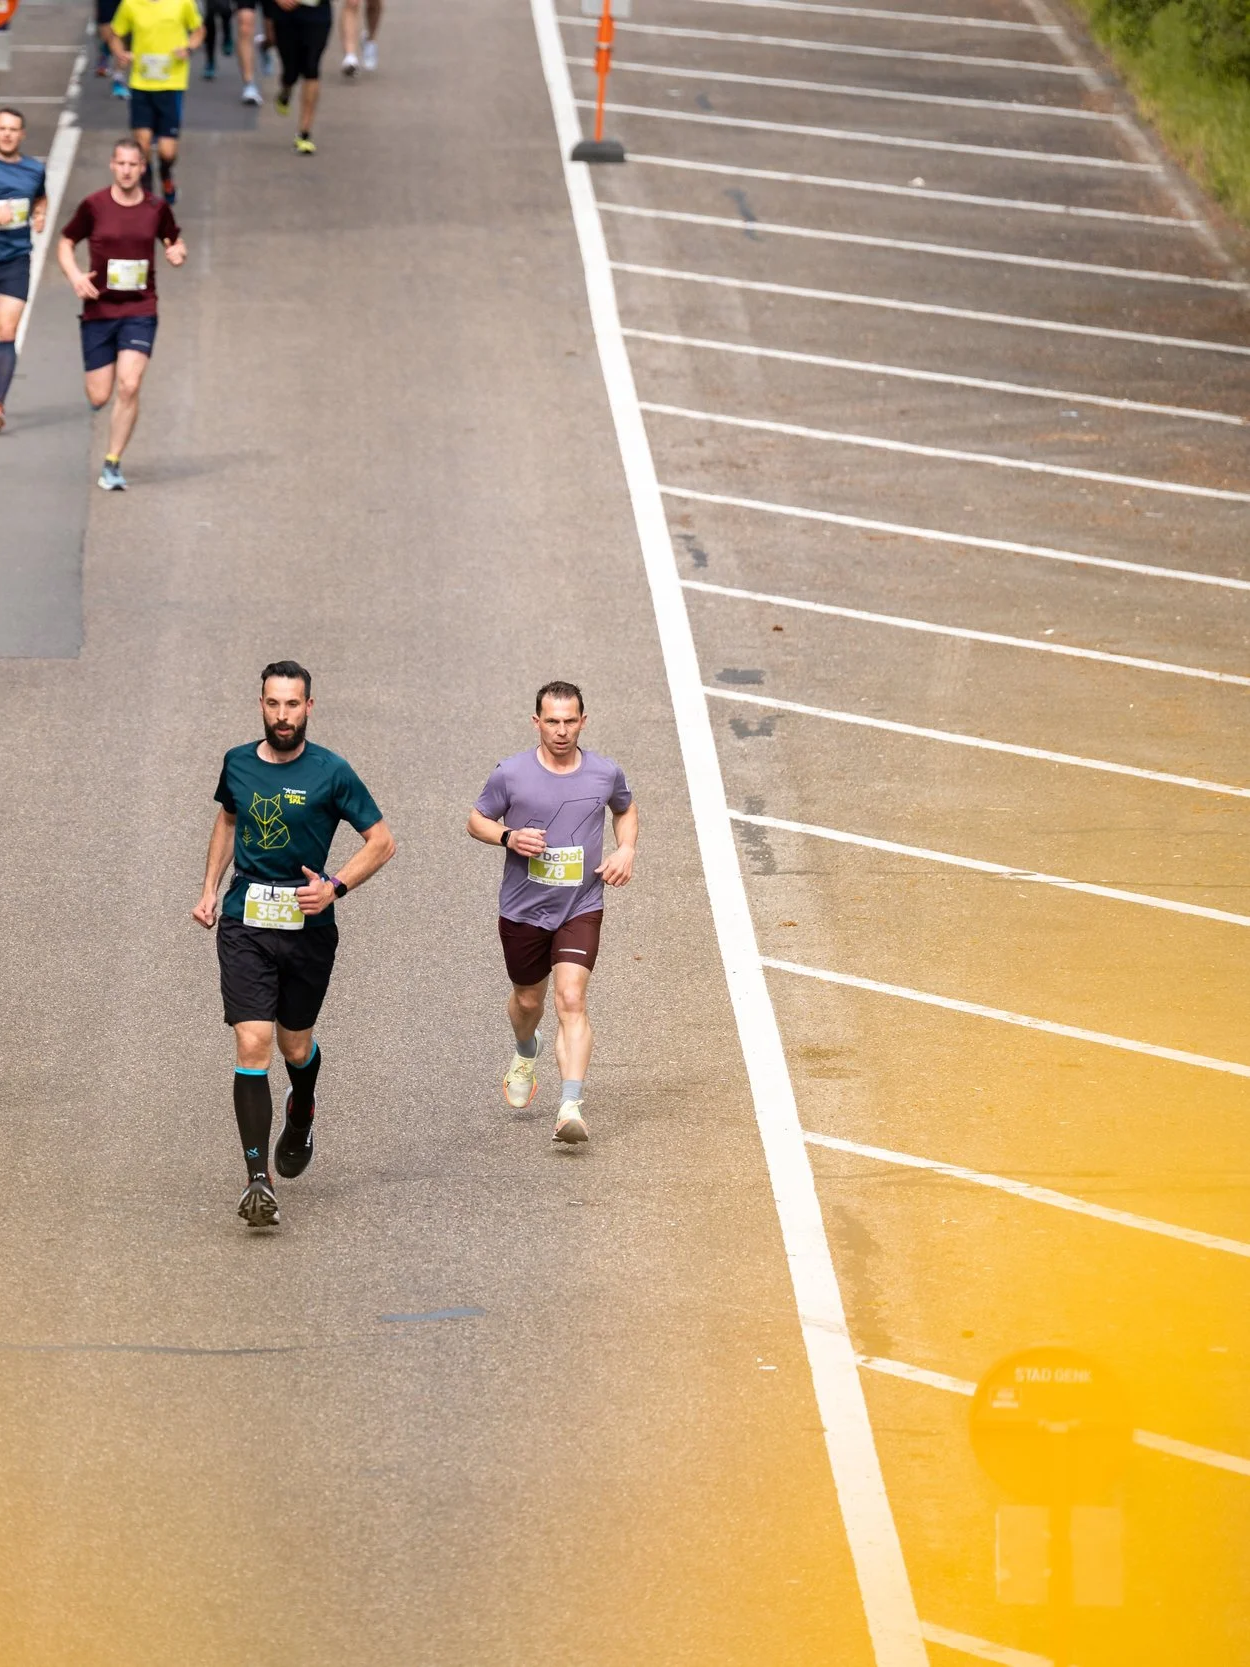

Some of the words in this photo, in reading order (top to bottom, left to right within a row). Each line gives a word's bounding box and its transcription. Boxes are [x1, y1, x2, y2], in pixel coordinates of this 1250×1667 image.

[544, 849, 582, 862] bebat
[544, 864, 565, 879] 78
[263, 889, 297, 903] beba
[257, 904, 293, 921] 354
[1014, 1367, 1051, 1383] STAD
